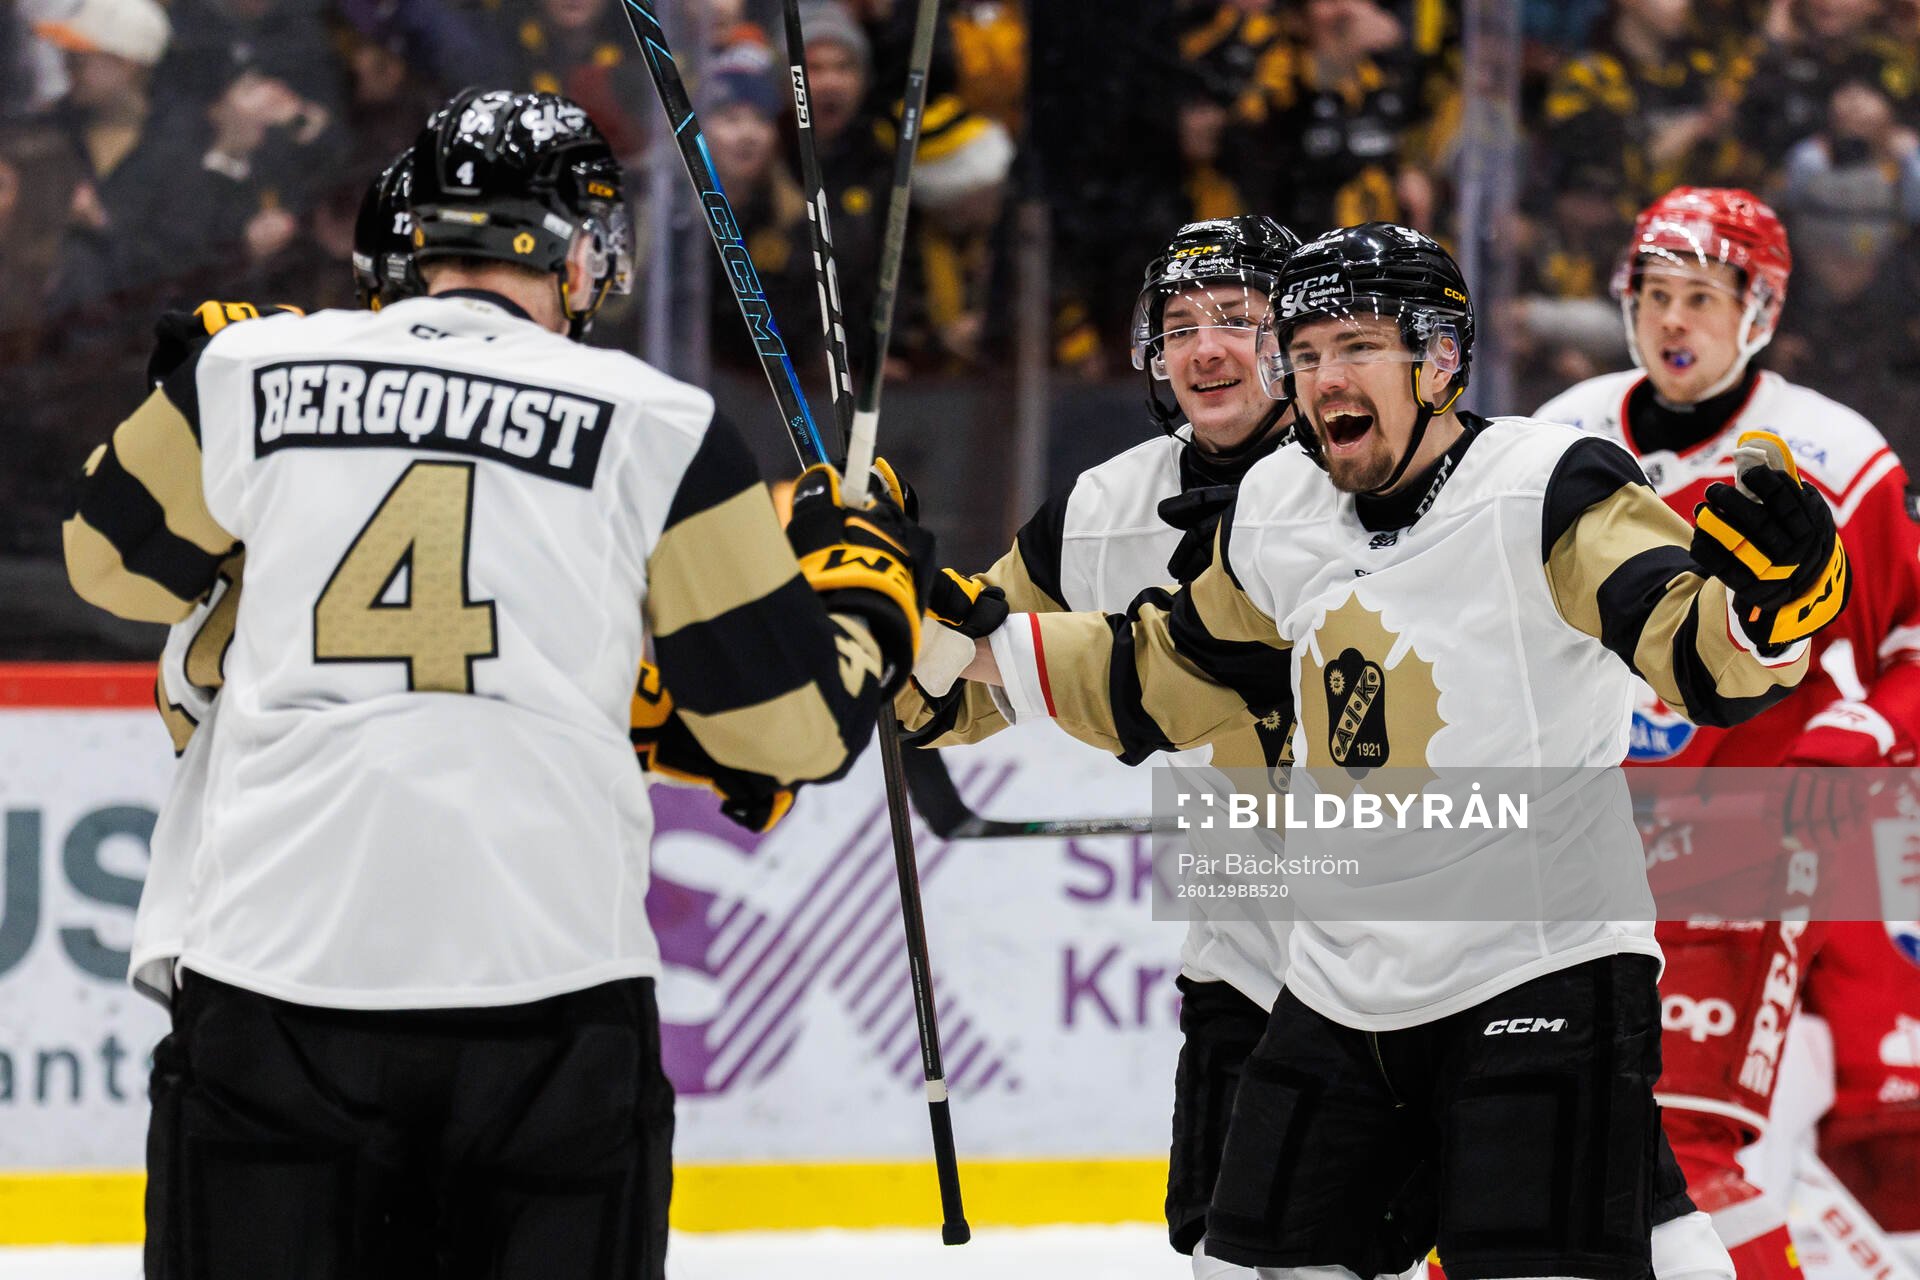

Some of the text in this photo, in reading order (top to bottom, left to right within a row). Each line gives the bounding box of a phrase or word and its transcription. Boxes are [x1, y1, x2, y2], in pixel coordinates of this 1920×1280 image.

[791, 70, 809, 124] CCM
[456, 160, 475, 185] 4
[1175, 245, 1221, 259] CCM
[701, 191, 788, 357] CCM
[1288, 272, 1340, 294] CCM
[1280, 289, 1310, 318] SK
[1309, 284, 1345, 299] Skellefteå
[1443, 287, 1467, 305] CCM
[260, 365, 599, 469] BERGQVIST
[312, 459, 499, 694] 4
[1356, 742, 1381, 757] 1921
[1062, 944, 1184, 1029] Kr
[1483, 1018, 1566, 1036] CCM
